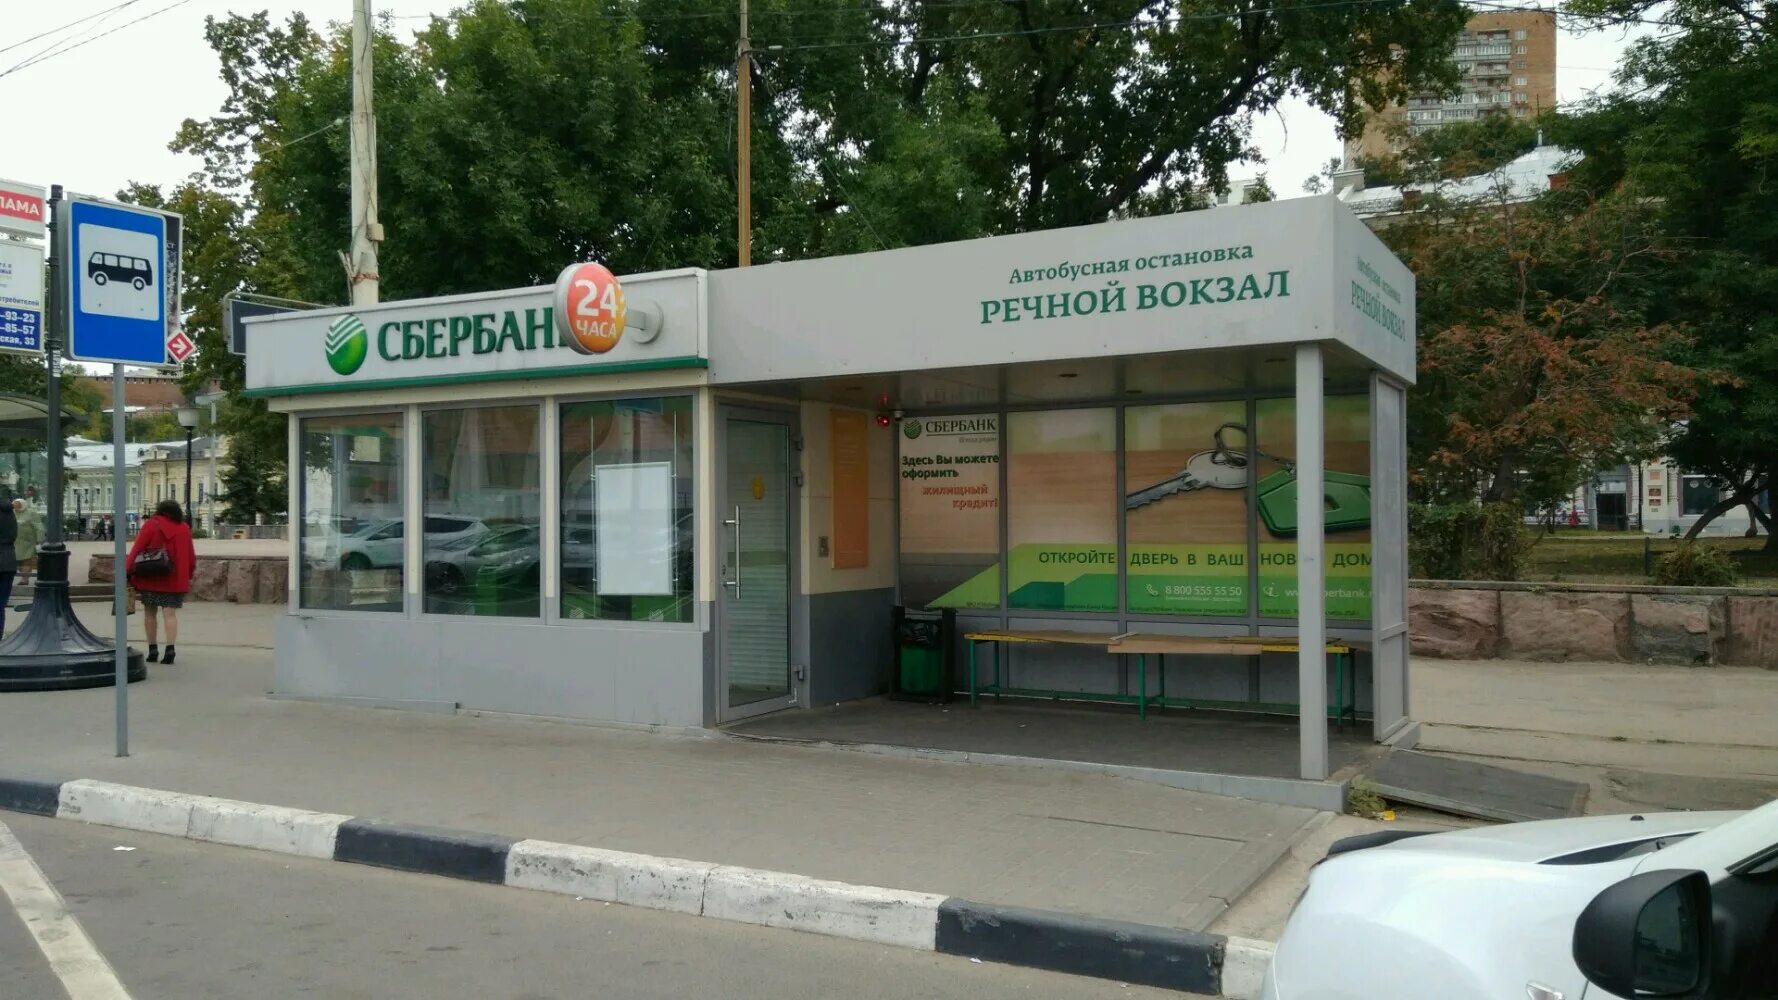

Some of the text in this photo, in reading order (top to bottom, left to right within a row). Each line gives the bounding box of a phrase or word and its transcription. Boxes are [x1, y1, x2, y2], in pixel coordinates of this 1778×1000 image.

[1009, 245, 1254, 284] Автобусная остановка
[575, 280, 618, 318] 24
[980, 270, 1291, 324] РЕЧНОЙ ВОКЗАЛ
[1351, 280, 1381, 325] РЕЧНОЙ
[377, 306, 567, 362] СБЕРБАН
[576, 320, 618, 338] ЧАСА
[926, 419, 996, 433] СБЕРБАНК
[902, 454, 1000, 467] Здесь Вы можете
[902, 468, 959, 480] оформить
[922, 484, 989, 496] жилищный
[953, 498, 998, 510] кредит!
[1038, 550, 1372, 568] ОТКРОЙТЕ ДВЕРЬ В ВАШ НОВ ДОМ
[1165, 585, 1242, 597] 8 800 555 55 50
